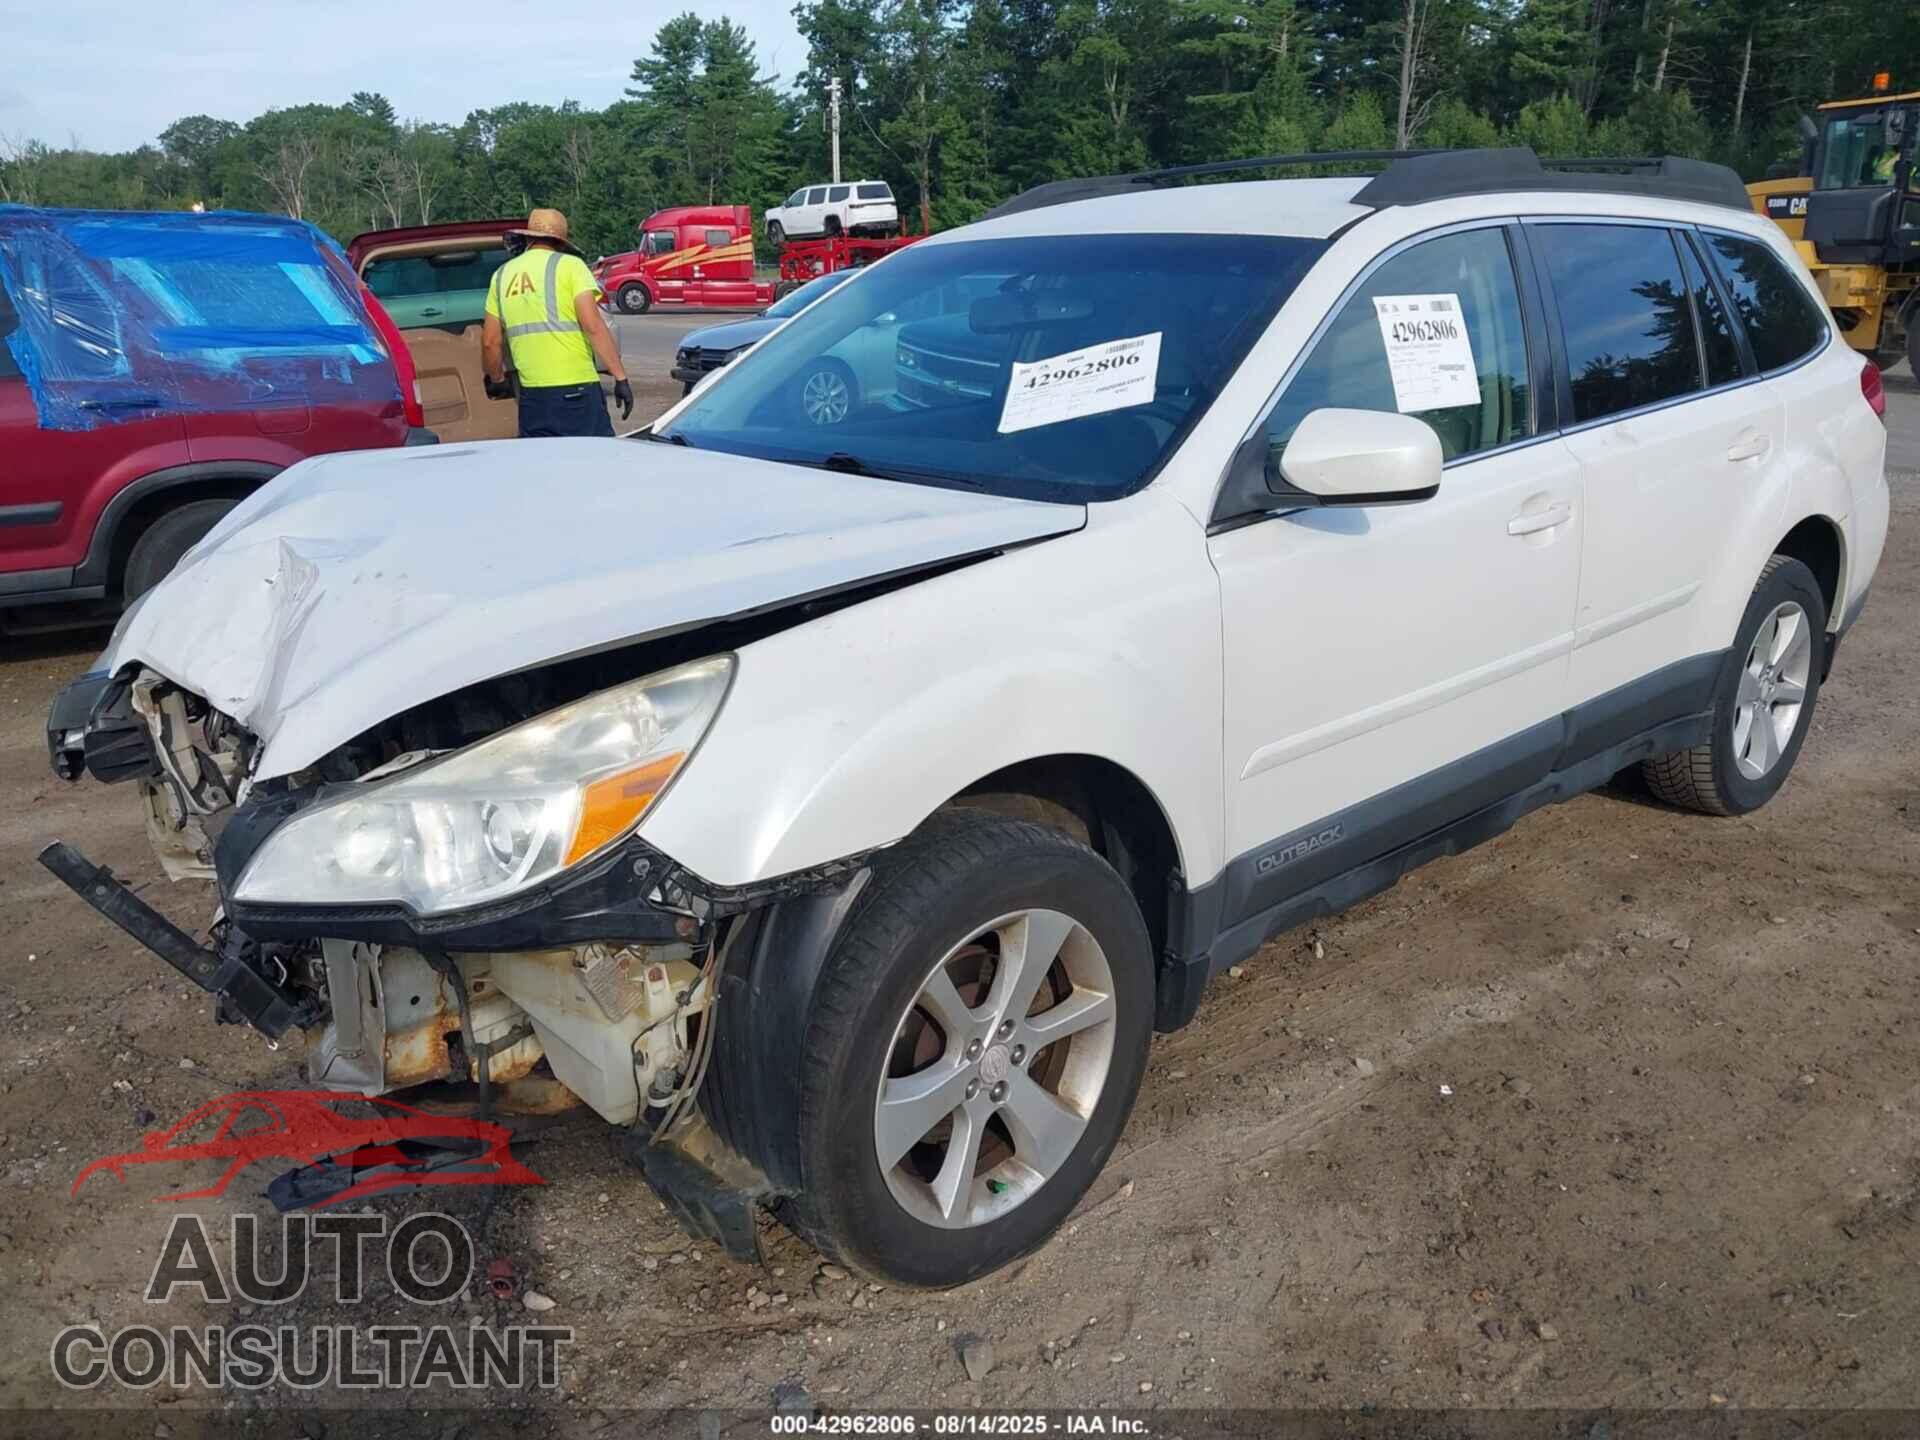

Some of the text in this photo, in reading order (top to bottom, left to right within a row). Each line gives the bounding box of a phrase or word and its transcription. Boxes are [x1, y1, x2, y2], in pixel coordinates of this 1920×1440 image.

[1790, 197, 1809, 215] CA
[1392, 319, 1458, 342] 42962806
[1024, 352, 1140, 389] 42962806
[1258, 824, 1342, 872] OUTBACK
